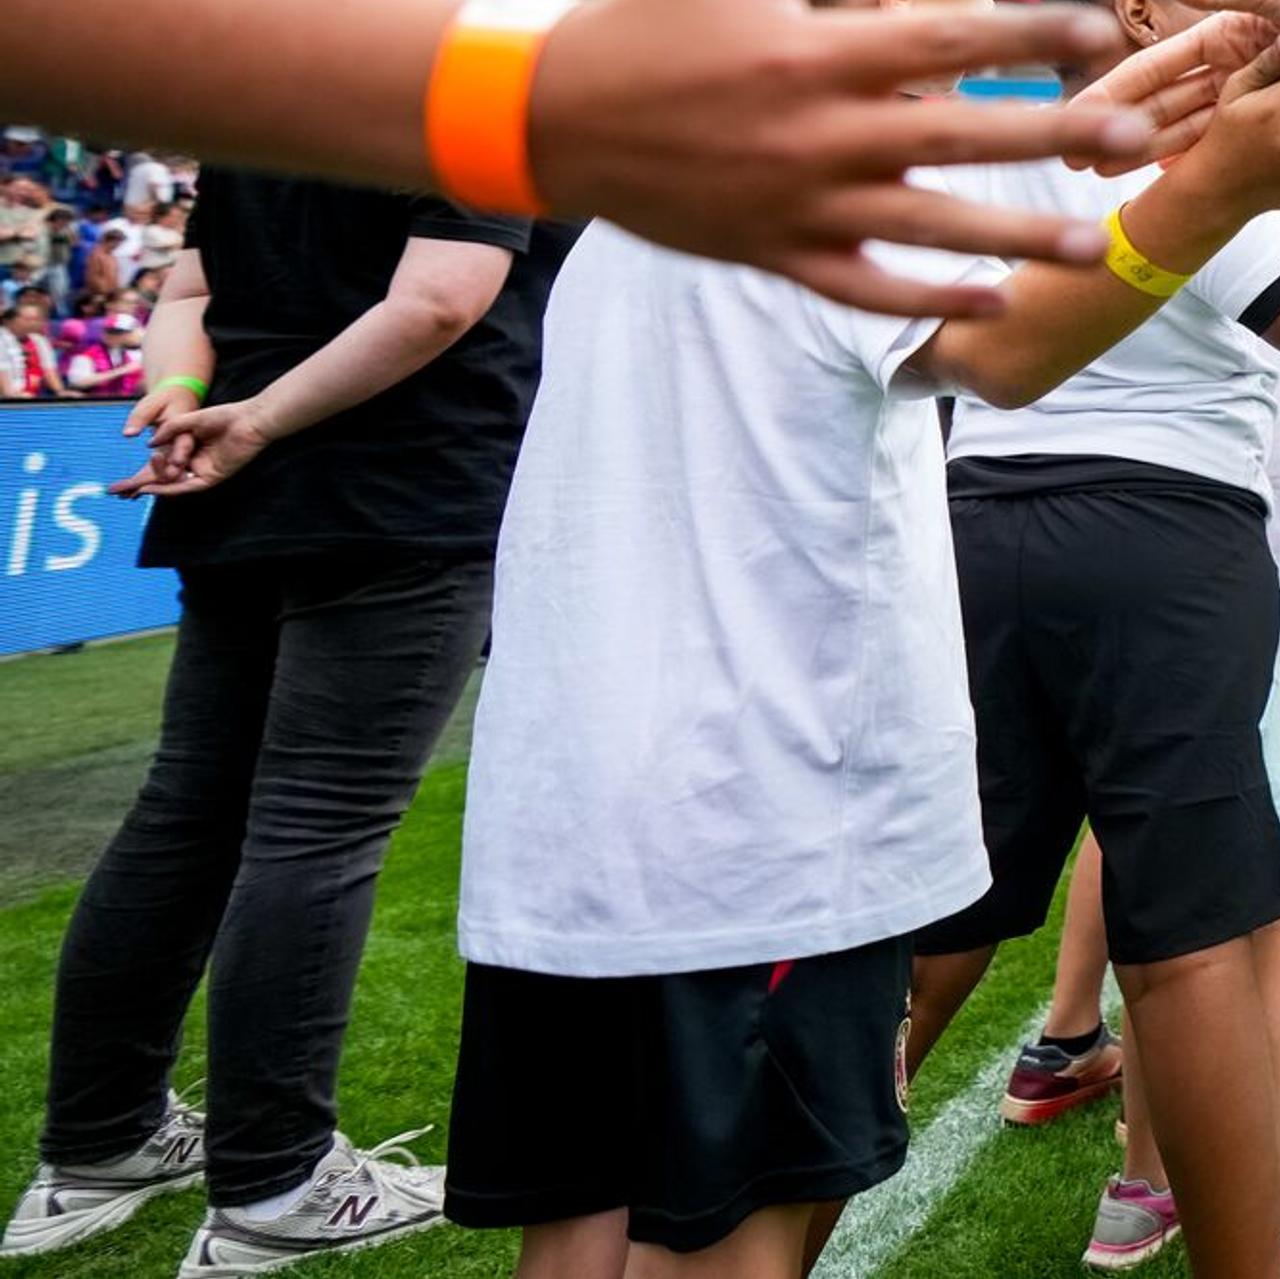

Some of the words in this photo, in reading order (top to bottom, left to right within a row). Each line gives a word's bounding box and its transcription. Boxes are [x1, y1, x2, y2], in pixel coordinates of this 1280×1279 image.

[7, 451, 104, 576] is
[162, 1136, 200, 1164] N
[325, 1194, 380, 1228] N
